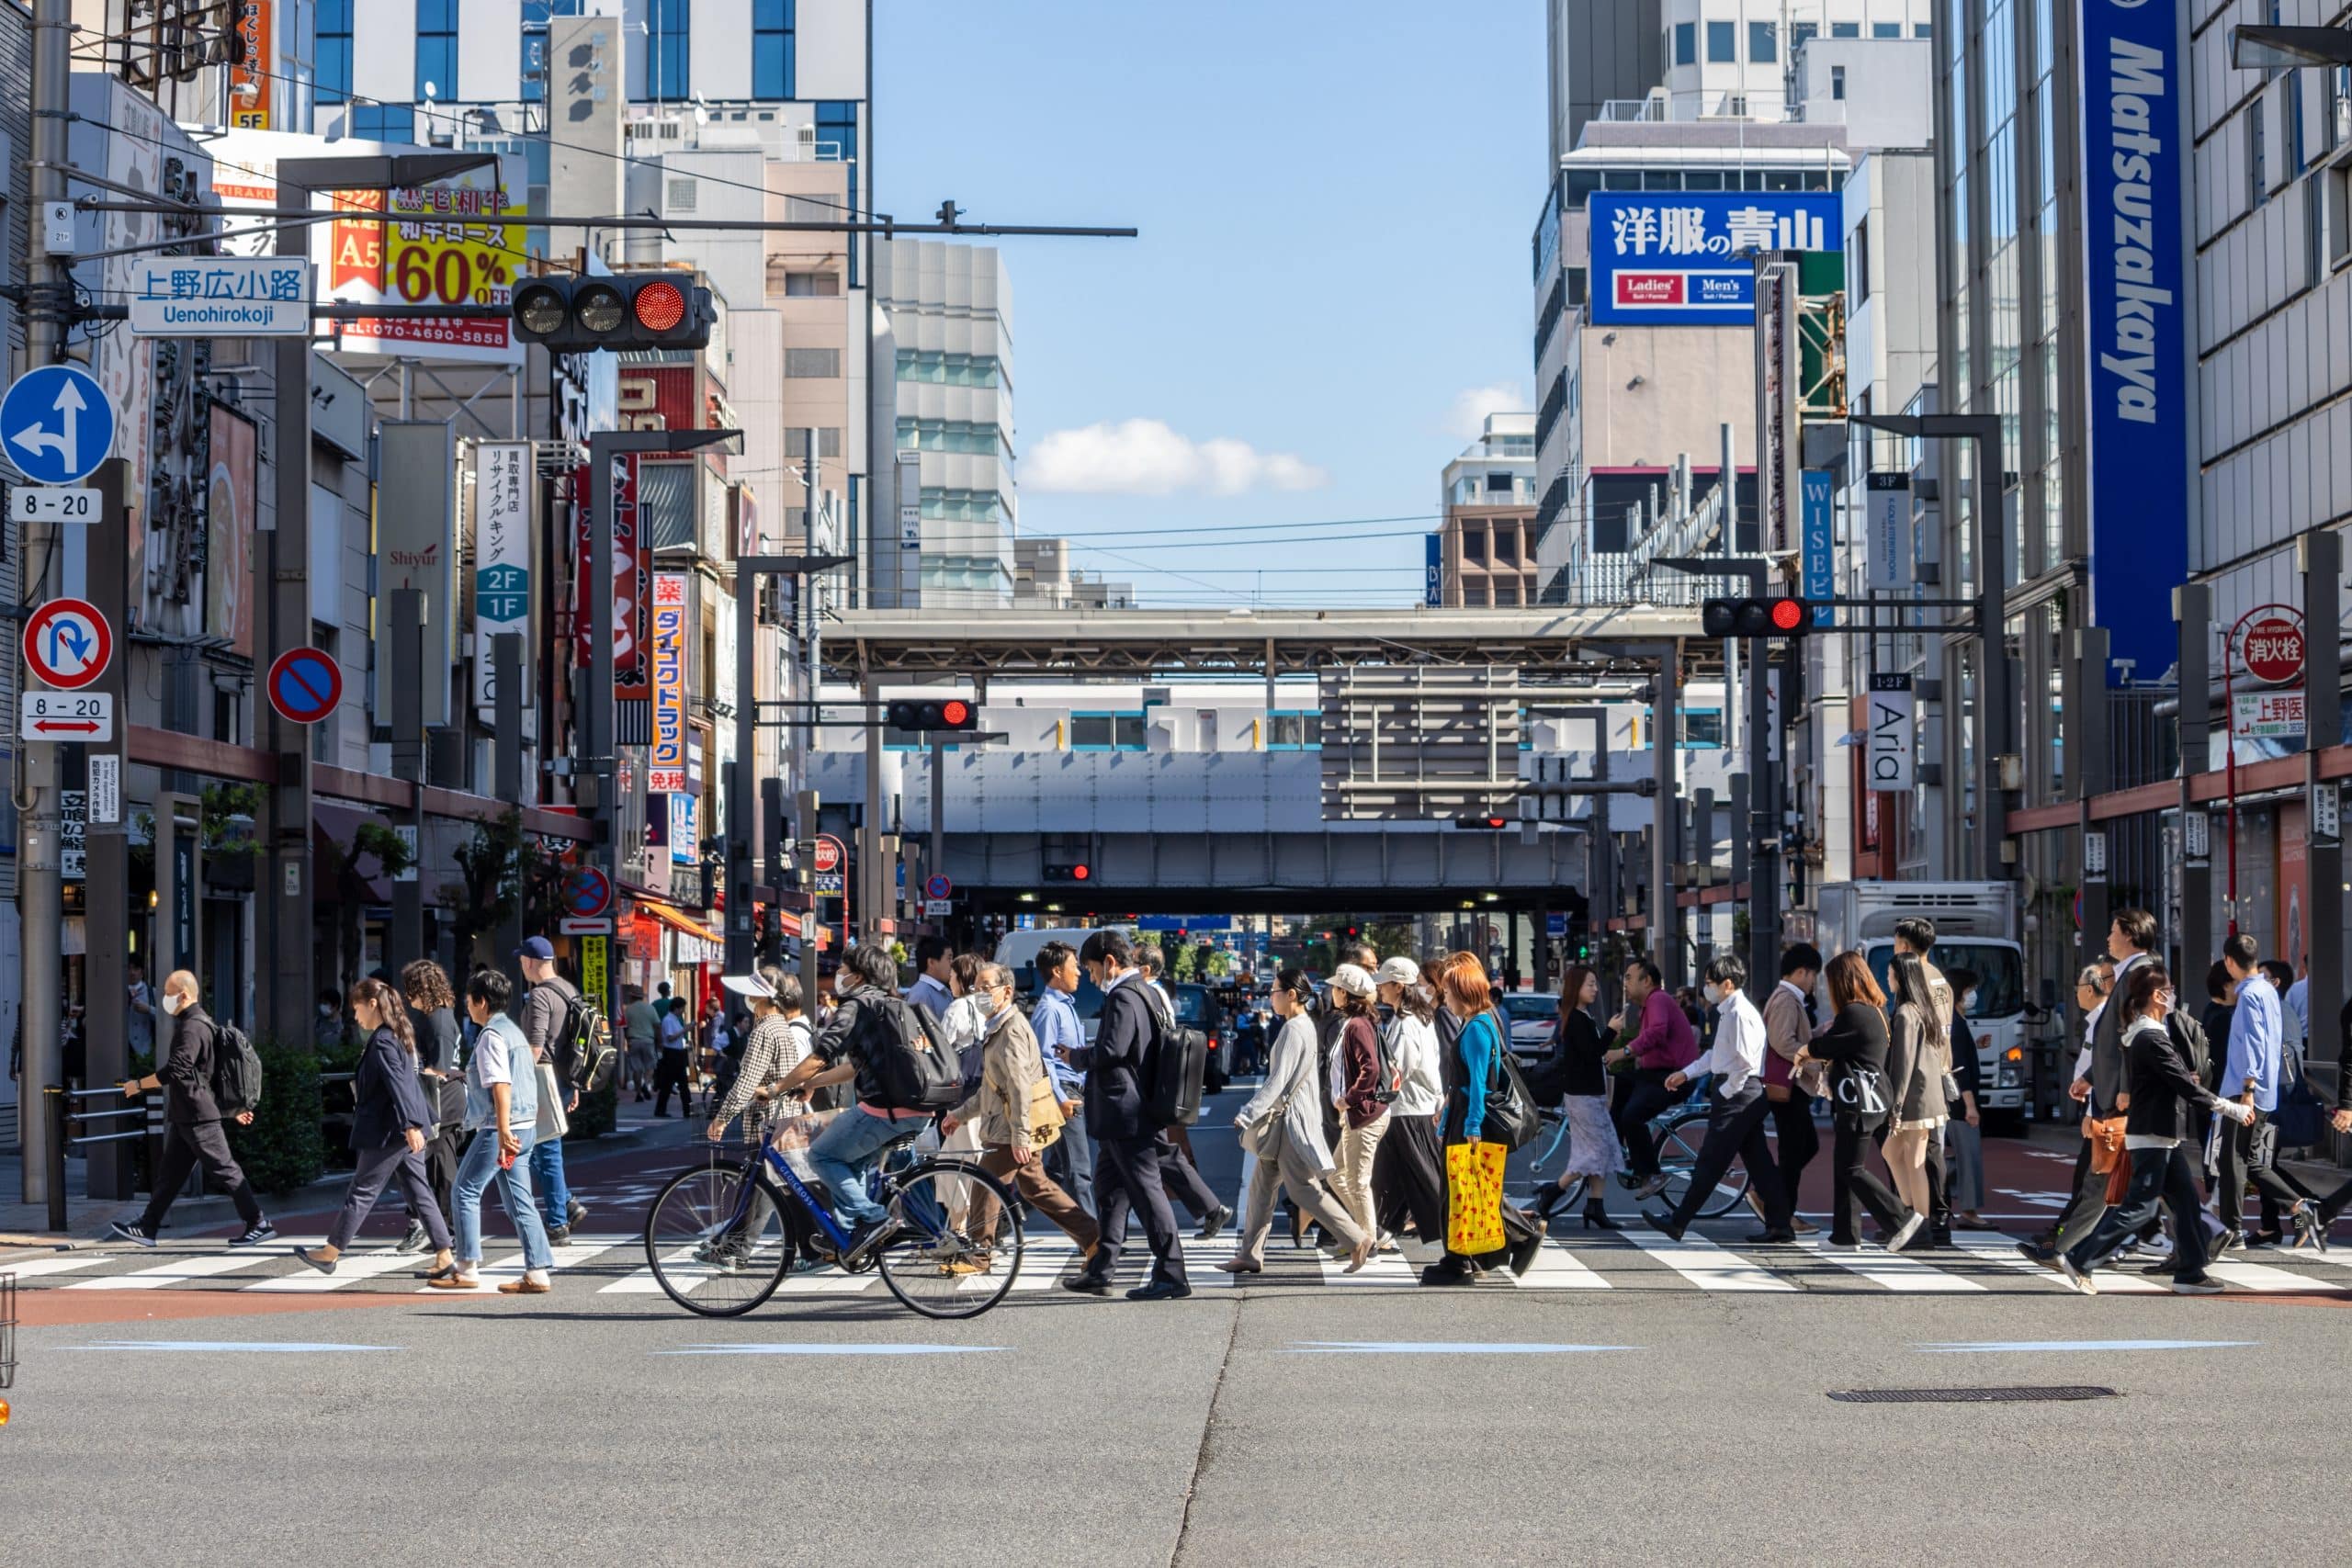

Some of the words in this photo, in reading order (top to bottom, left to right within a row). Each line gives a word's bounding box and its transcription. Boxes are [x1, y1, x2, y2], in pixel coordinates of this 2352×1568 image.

[399, 220, 506, 247] 和牛ロース
[1611, 206, 1825, 256] 洋服の青山
[2100, 37, 2172, 423] Matsuzakaya
[336, 234, 381, 268] A5
[138, 269, 301, 301] 上野広小路
[474, 288, 510, 305] OFF
[1702, 279, 1739, 291] Men's
[164, 306, 274, 325] Uenohirokoji
[343, 322, 503, 344] EL:070-4690-5858
[507, 451, 519, 513] 買取専門店
[1879, 476, 1897, 487] 3F
[489, 450, 505, 562] リサイクルキング
[488, 570, 518, 589] 2F
[656, 576, 682, 603] 薬
[490, 598, 518, 616] 1F
[2249, 637, 2301, 663] 消火栓
[656, 610, 681, 761] ダイコクドラッグ
[2257, 697, 2305, 723] 上野医
[1875, 702, 1905, 780] Aria
[650, 773, 685, 791] 免税
